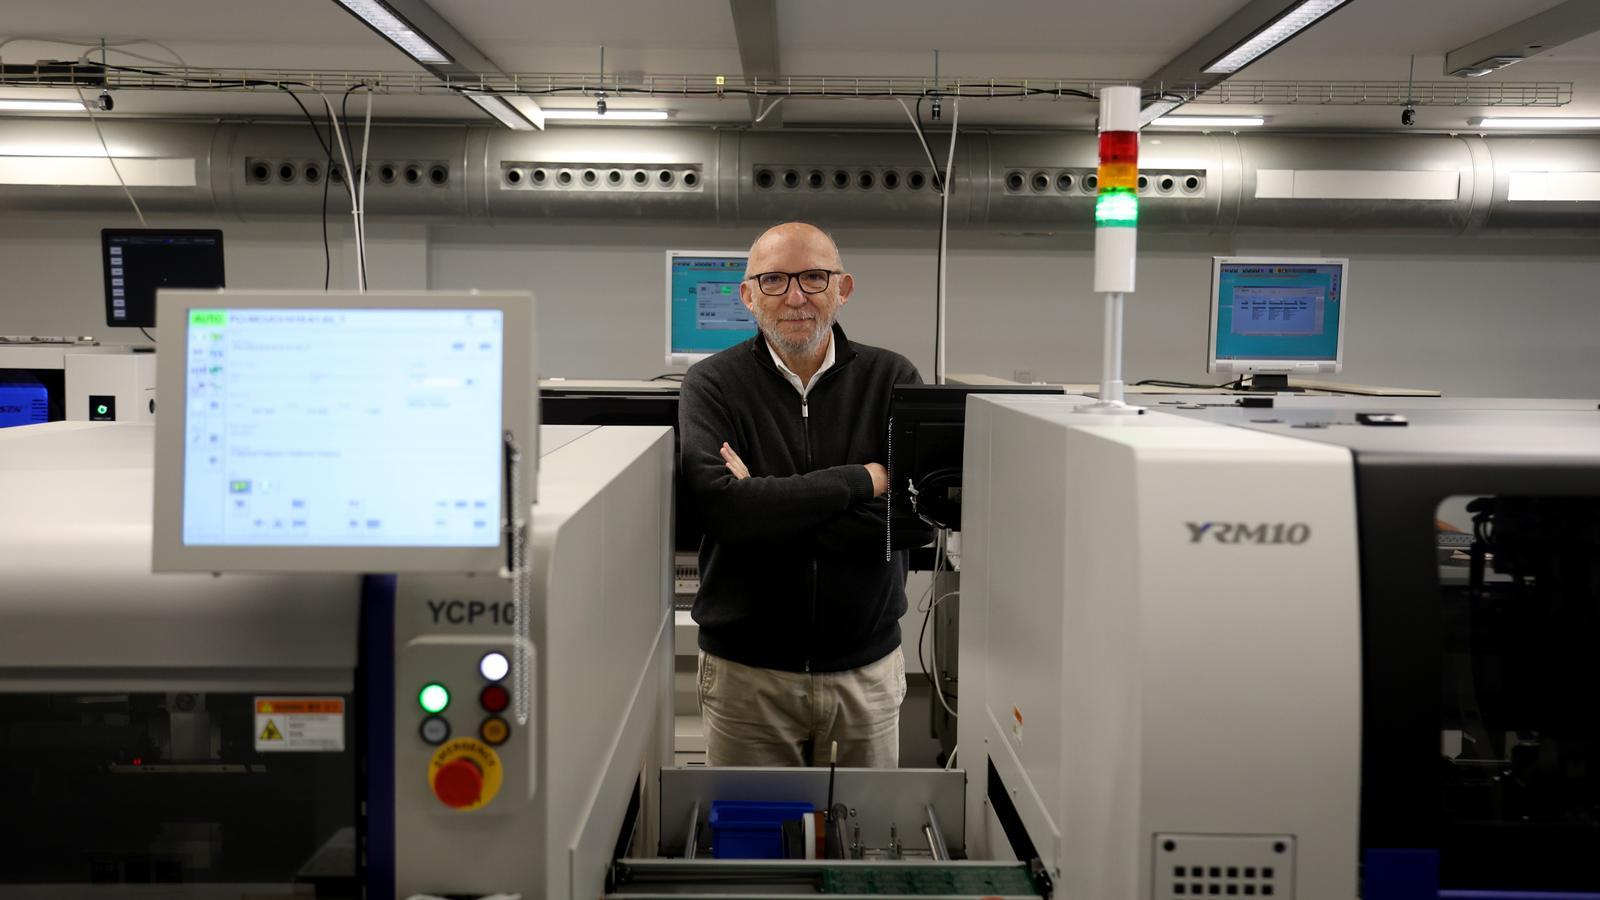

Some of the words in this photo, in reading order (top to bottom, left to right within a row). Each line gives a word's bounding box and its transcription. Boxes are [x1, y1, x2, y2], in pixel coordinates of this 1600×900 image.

[1184, 522, 1311, 545] YRM10
[427, 600, 516, 625] YCP10
[434, 742, 496, 768] EMERGENCY
